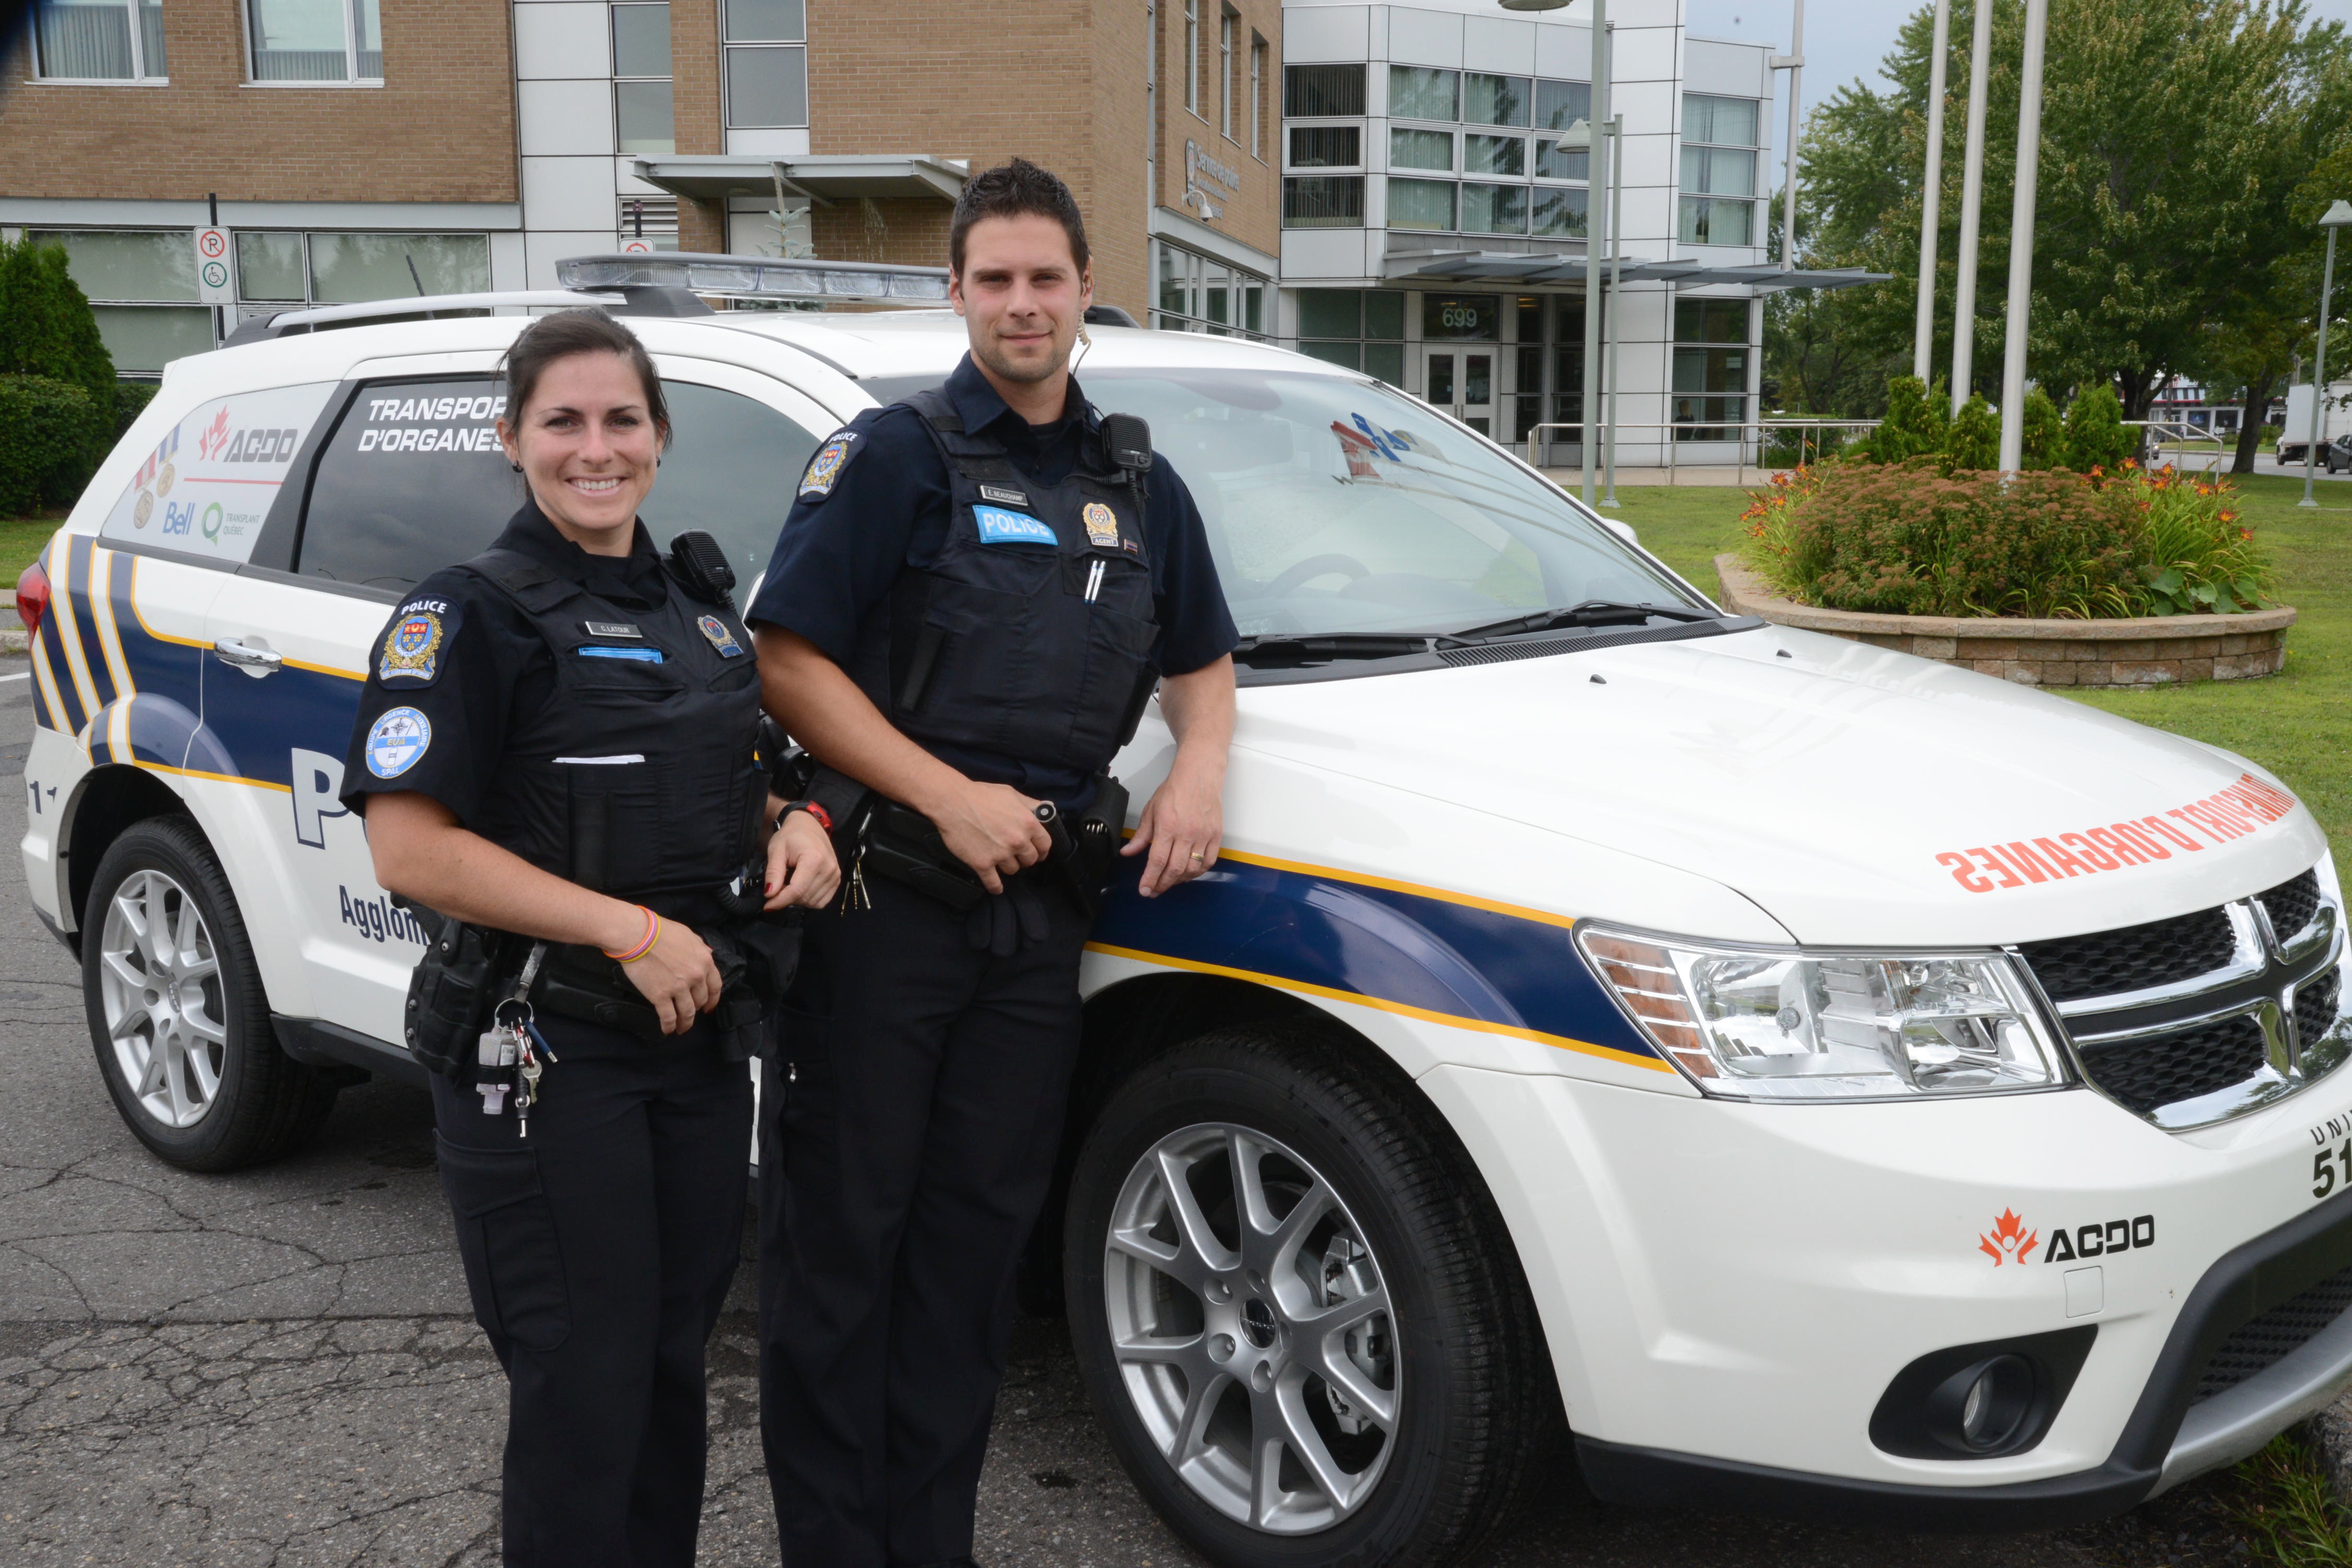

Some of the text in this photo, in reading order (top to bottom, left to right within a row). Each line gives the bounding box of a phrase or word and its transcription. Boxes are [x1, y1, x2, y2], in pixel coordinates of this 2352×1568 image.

[1442, 308, 1477, 327] 699
[223, 429, 298, 462] ACDO
[162, 501, 195, 535] Bell
[226, 513, 260, 523] TRANSPLANT
[983, 513, 1049, 536] POLICE
[223, 523, 244, 535] QUÉBEC
[401, 600, 447, 615] POLICE
[395, 644, 427, 657] LONGUEUIL
[379, 709, 410, 725] URGENCE
[413, 714, 428, 747] AUXILIAIRE
[387, 738, 406, 746] EUA
[381, 767, 399, 776] SPAL
[2310, 1109, 2352, 1146] UNI
[2312, 1137, 2352, 1198] 51
[2044, 1214, 2155, 1264] ACDO
